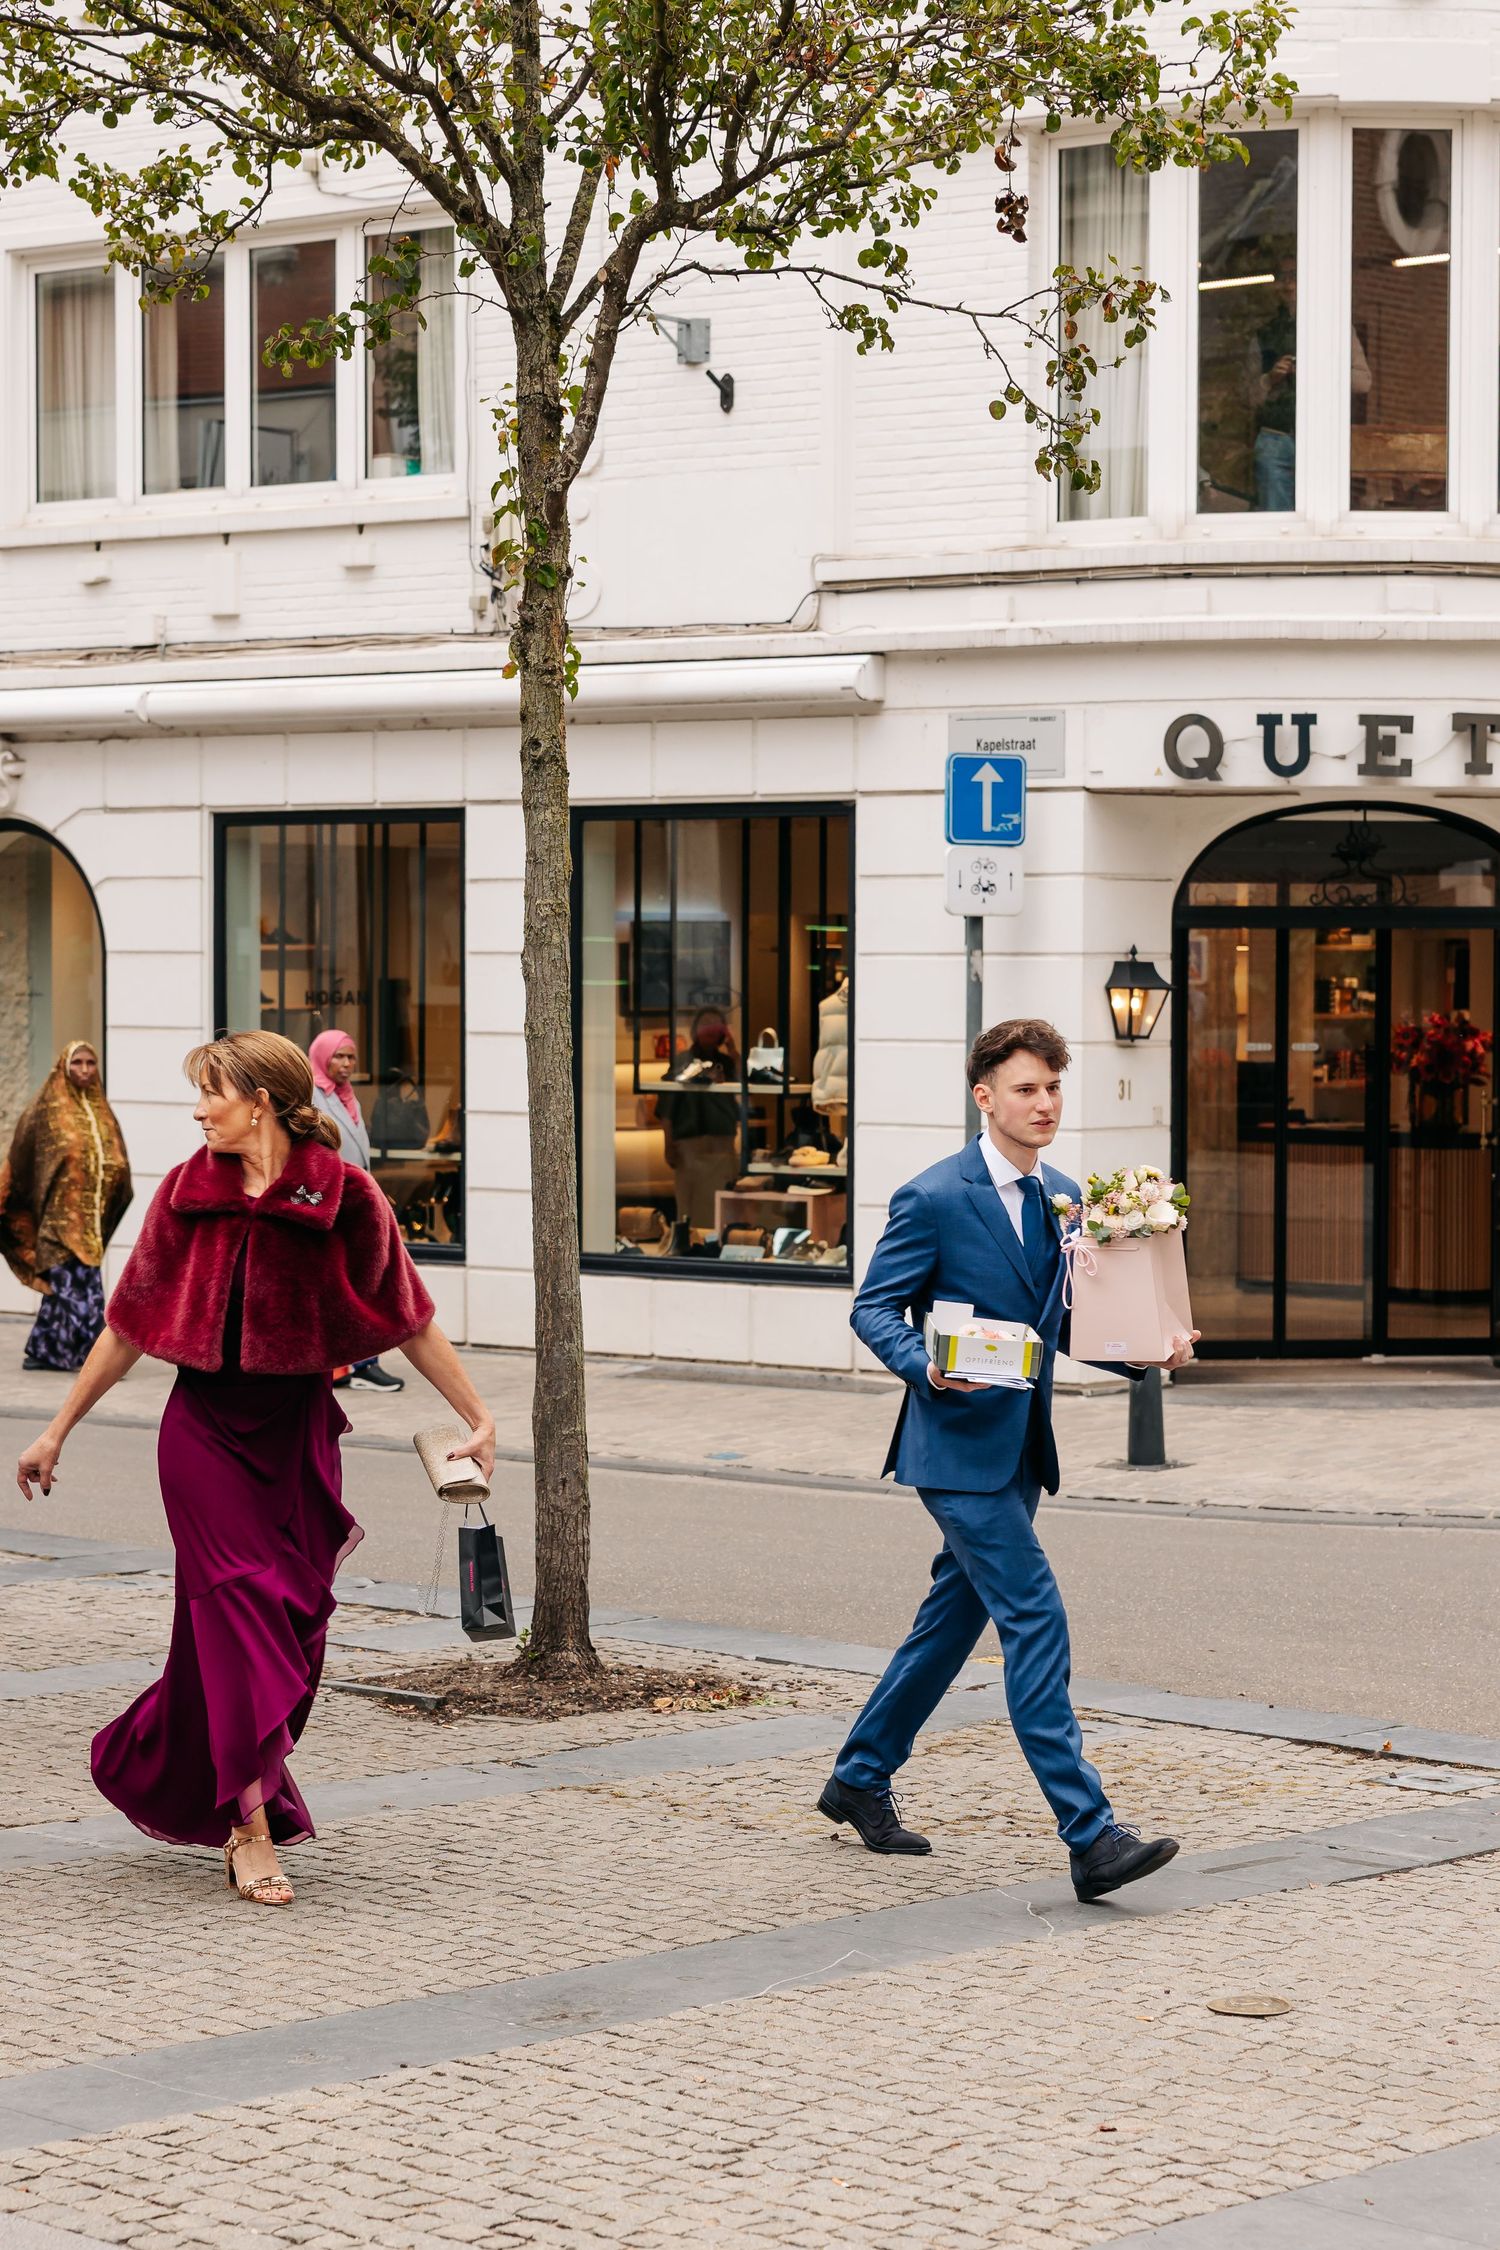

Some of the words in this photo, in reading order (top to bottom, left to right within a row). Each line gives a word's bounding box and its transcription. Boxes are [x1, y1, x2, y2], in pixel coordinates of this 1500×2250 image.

[976, 738, 1036, 755] Kapelstraat
[1163, 712, 1500, 781] QUET
[305, 990, 369, 1006] HOGAN
[1118, 1079, 1131, 1101] 31
[965, 1356, 1014, 1367] OPTIFRIEND
